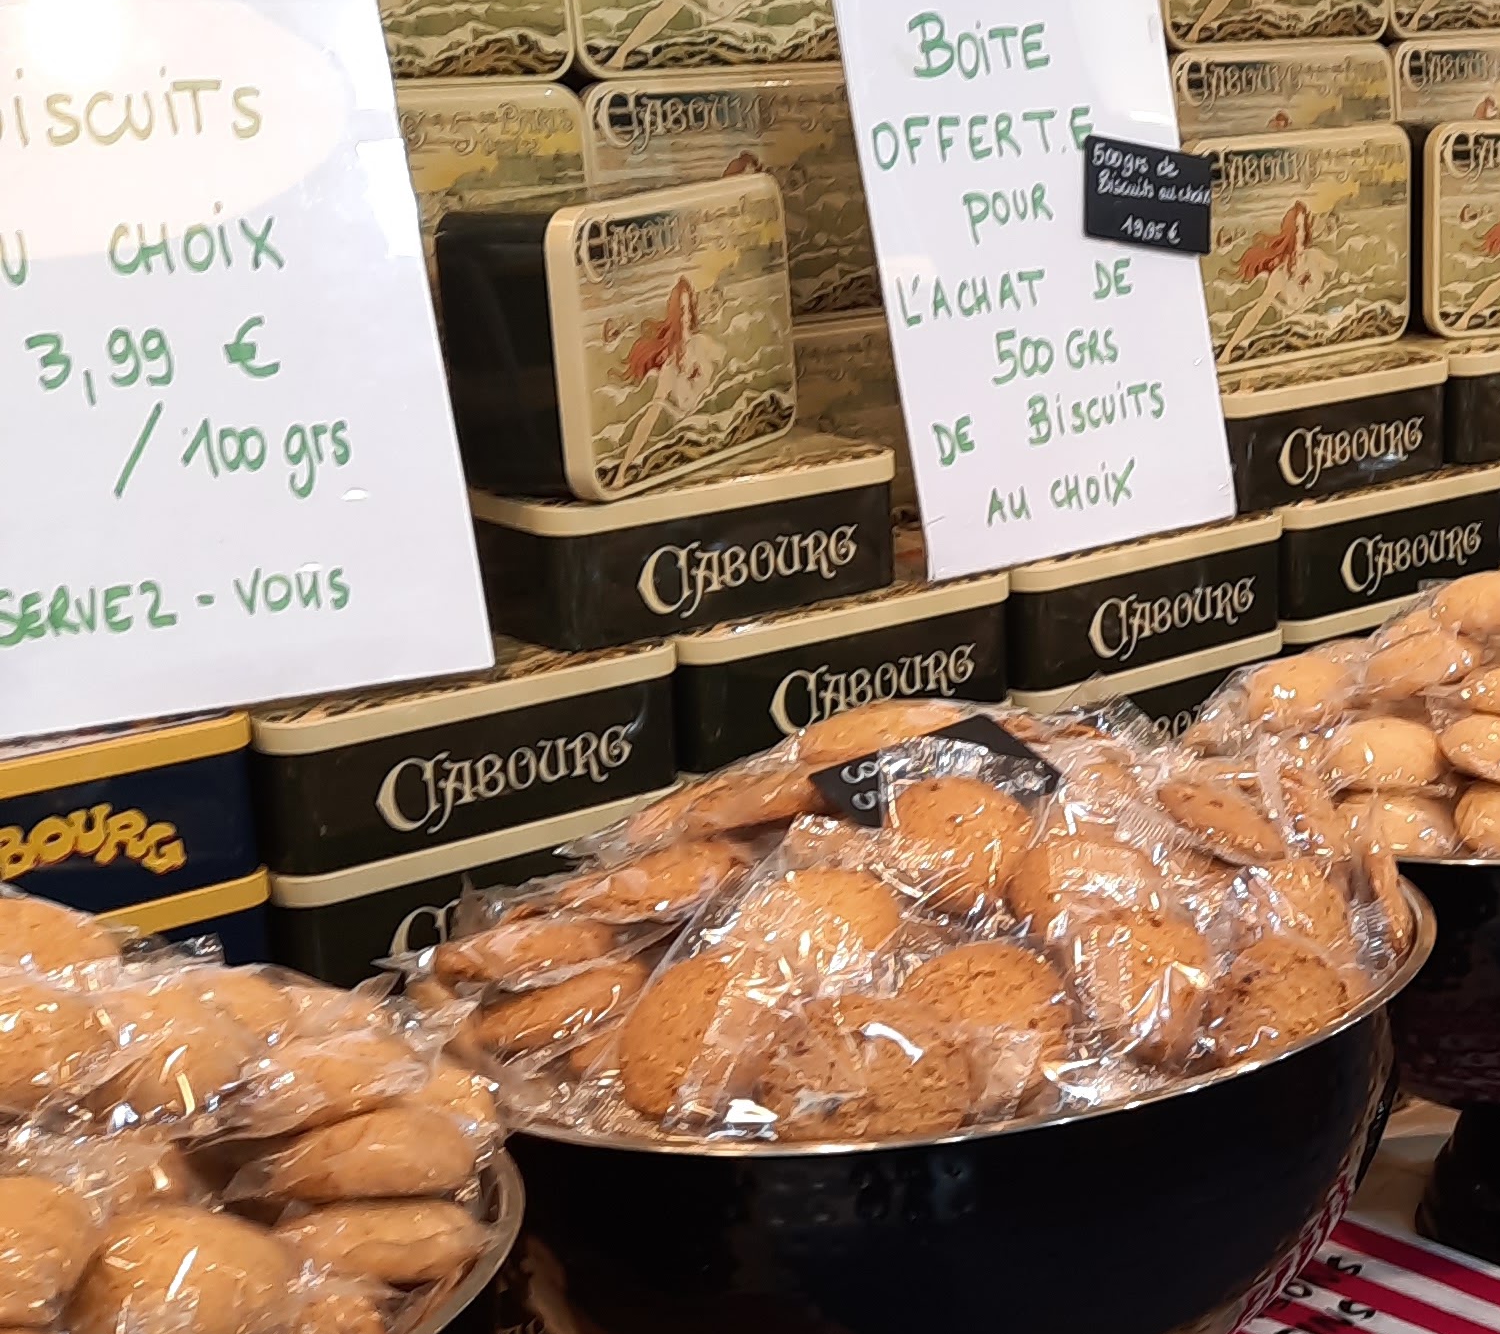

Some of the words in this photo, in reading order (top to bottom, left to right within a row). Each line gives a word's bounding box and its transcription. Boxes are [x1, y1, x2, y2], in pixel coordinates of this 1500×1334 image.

[907, 10, 1052, 80] BOITE
[0, 66, 262, 147] ISCUITS
[1155, 155, 1180, 179] de
[962, 183, 1054, 245] POUR
[897, 268, 1046, 328] L'ACHAT
[1094, 257, 1133, 301] DE
[25, 326, 174, 407] 3,99
[223, 314, 281, 379] €
[992, 328, 1054, 386] 500
[1066, 328, 1119, 369] GRS
[284, 419, 352, 499] grs
[932, 415, 976, 467] DE
[1278, 414, 1423, 488] CABOURG
[986, 486, 1032, 527] AU
[1050, 456, 1136, 512] CHOIX
[233, 566, 352, 616] VOUS
[635, 523, 859, 618] CABOURG
[1340, 521, 1483, 597] CABOURG
[1087, 578, 1257, 662] CABOURG
[769, 642, 978, 737] CABOURG
[375, 723, 638, 834] CABOURG
